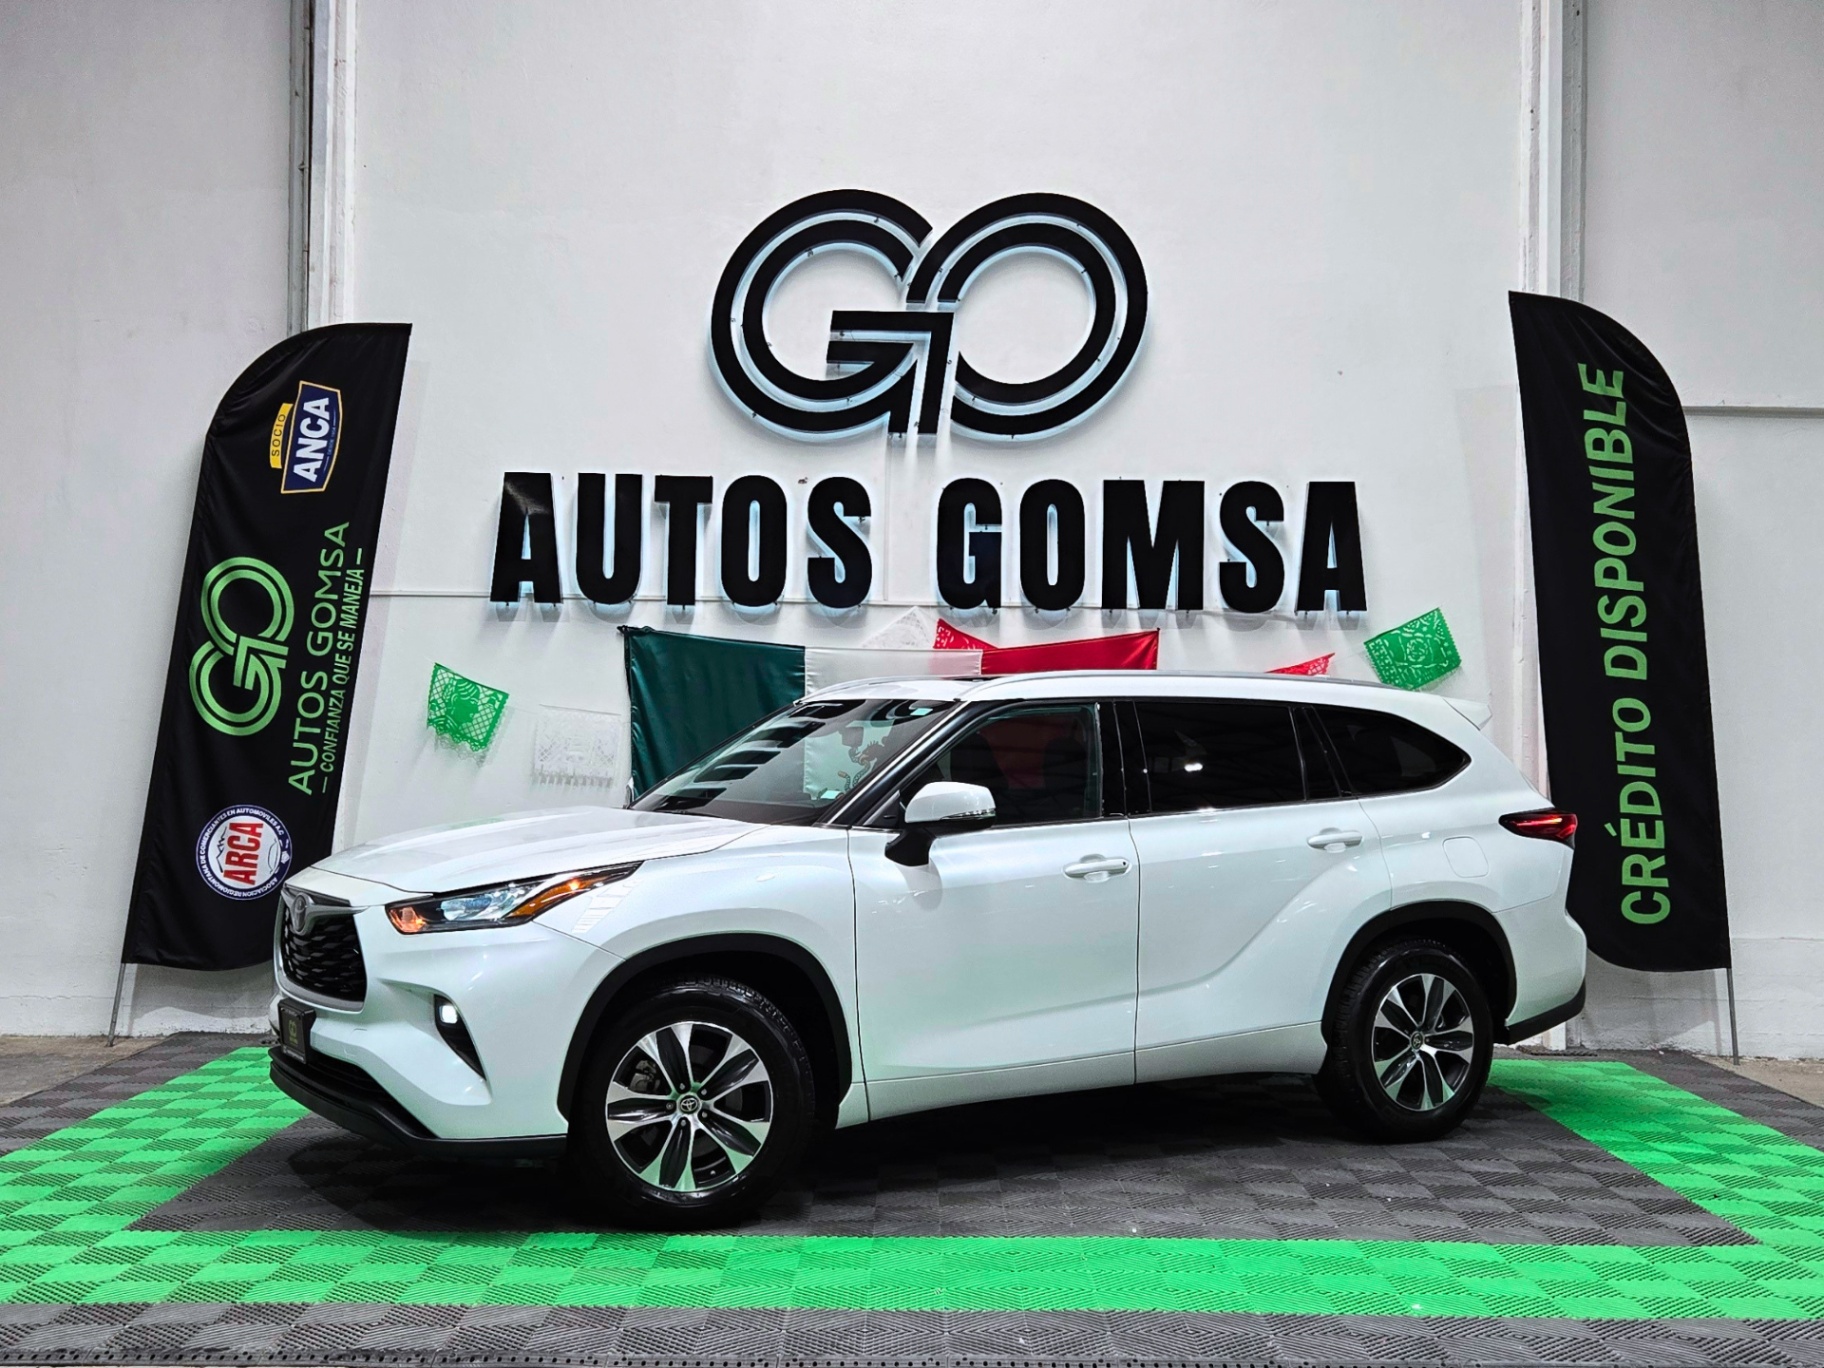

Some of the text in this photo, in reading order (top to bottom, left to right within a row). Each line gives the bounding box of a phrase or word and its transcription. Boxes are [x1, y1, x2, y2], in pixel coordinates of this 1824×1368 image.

[271, 413, 286, 457] SOCIO
[293, 397, 331, 483] ANCA
[490, 472, 1368, 613] AUTOS GOMSA
[288, 521, 350, 795] AUTOS GOMSA
[319, 569, 365, 772] CONFIANZA QUE SE MANEJA
[1576, 362, 1671, 924] CRÉDITO DISPONIBLE
[199, 812, 228, 854] COMERCIANTES
[227, 809, 236, 818] EN
[236, 807, 279, 827] AUTOMOVILES
[223, 822, 264, 886] ARCA
